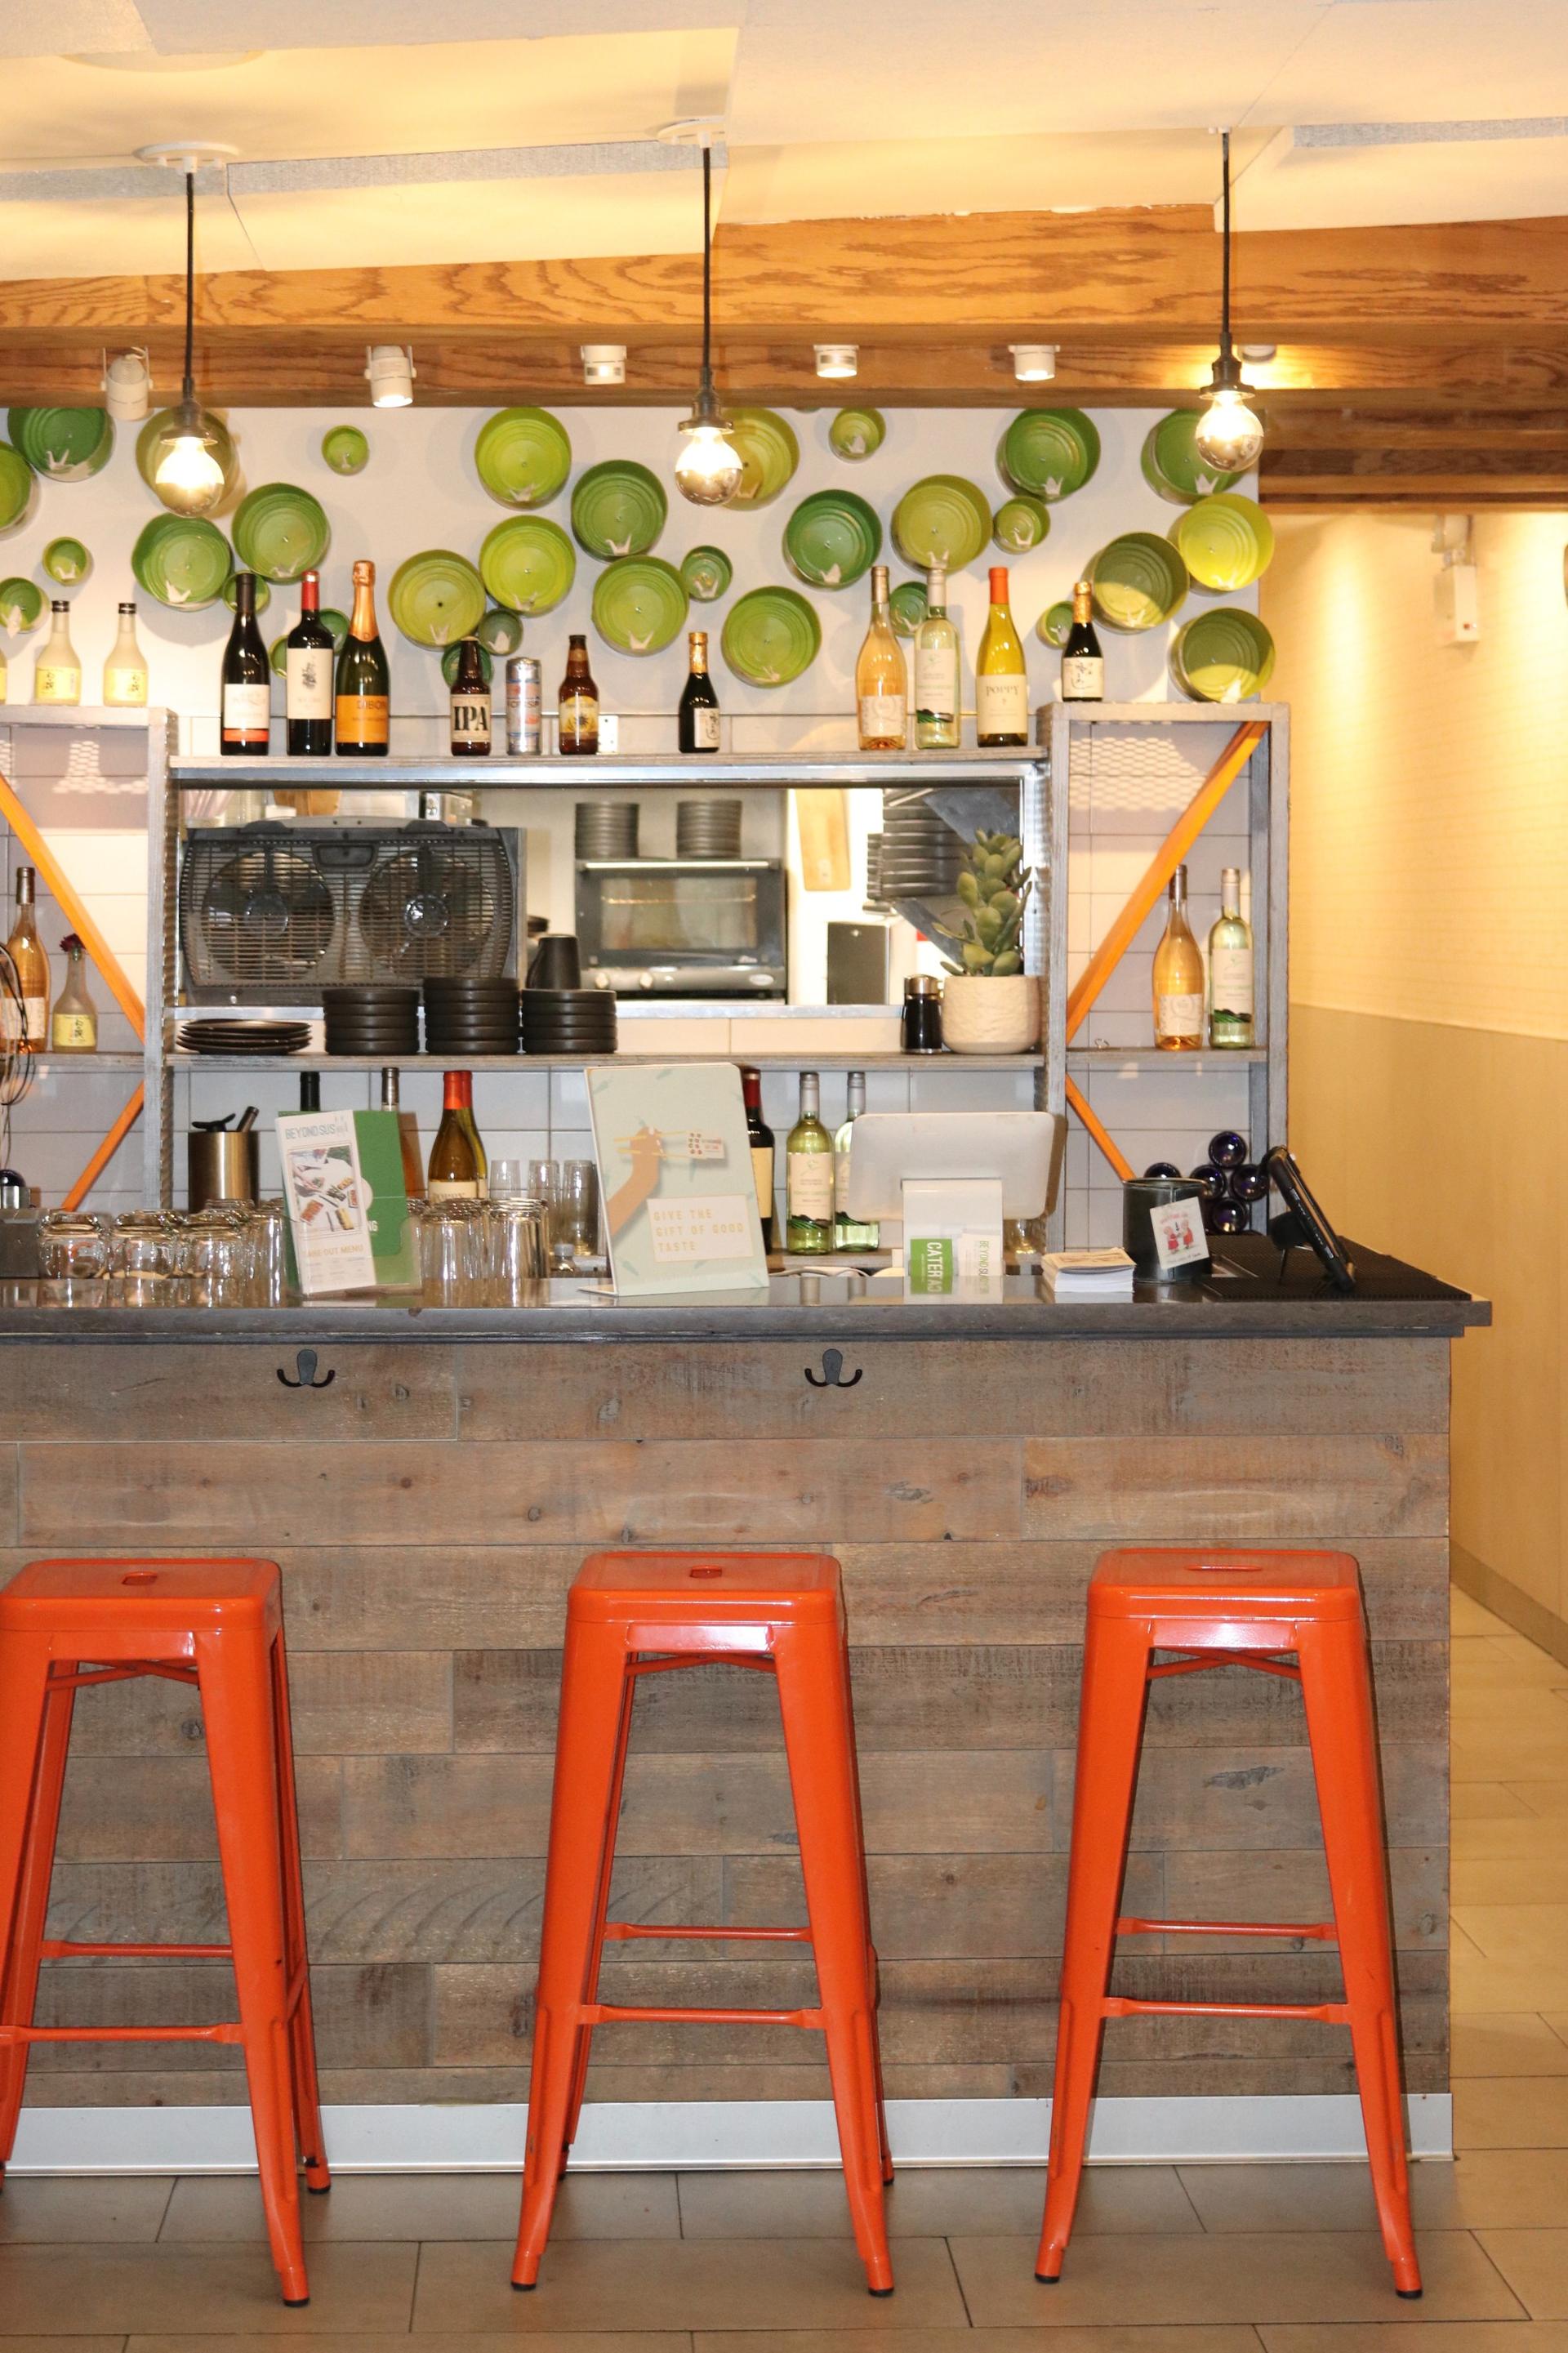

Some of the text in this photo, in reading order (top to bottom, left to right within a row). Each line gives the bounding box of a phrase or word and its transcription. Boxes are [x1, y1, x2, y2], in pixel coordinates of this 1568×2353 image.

[985, 684, 1020, 697] POPPY
[453, 706, 489, 731] IPA
[285, 1125, 318, 1139] BEYOND
[653, 1209, 712, 1221] GIVE THE
[656, 1223, 744, 1237] GIFT OF GOOD
[340, 1243, 364, 1254] MENU
[657, 1241, 696, 1251] TASTE
[927, 1241, 943, 1277] CATER
